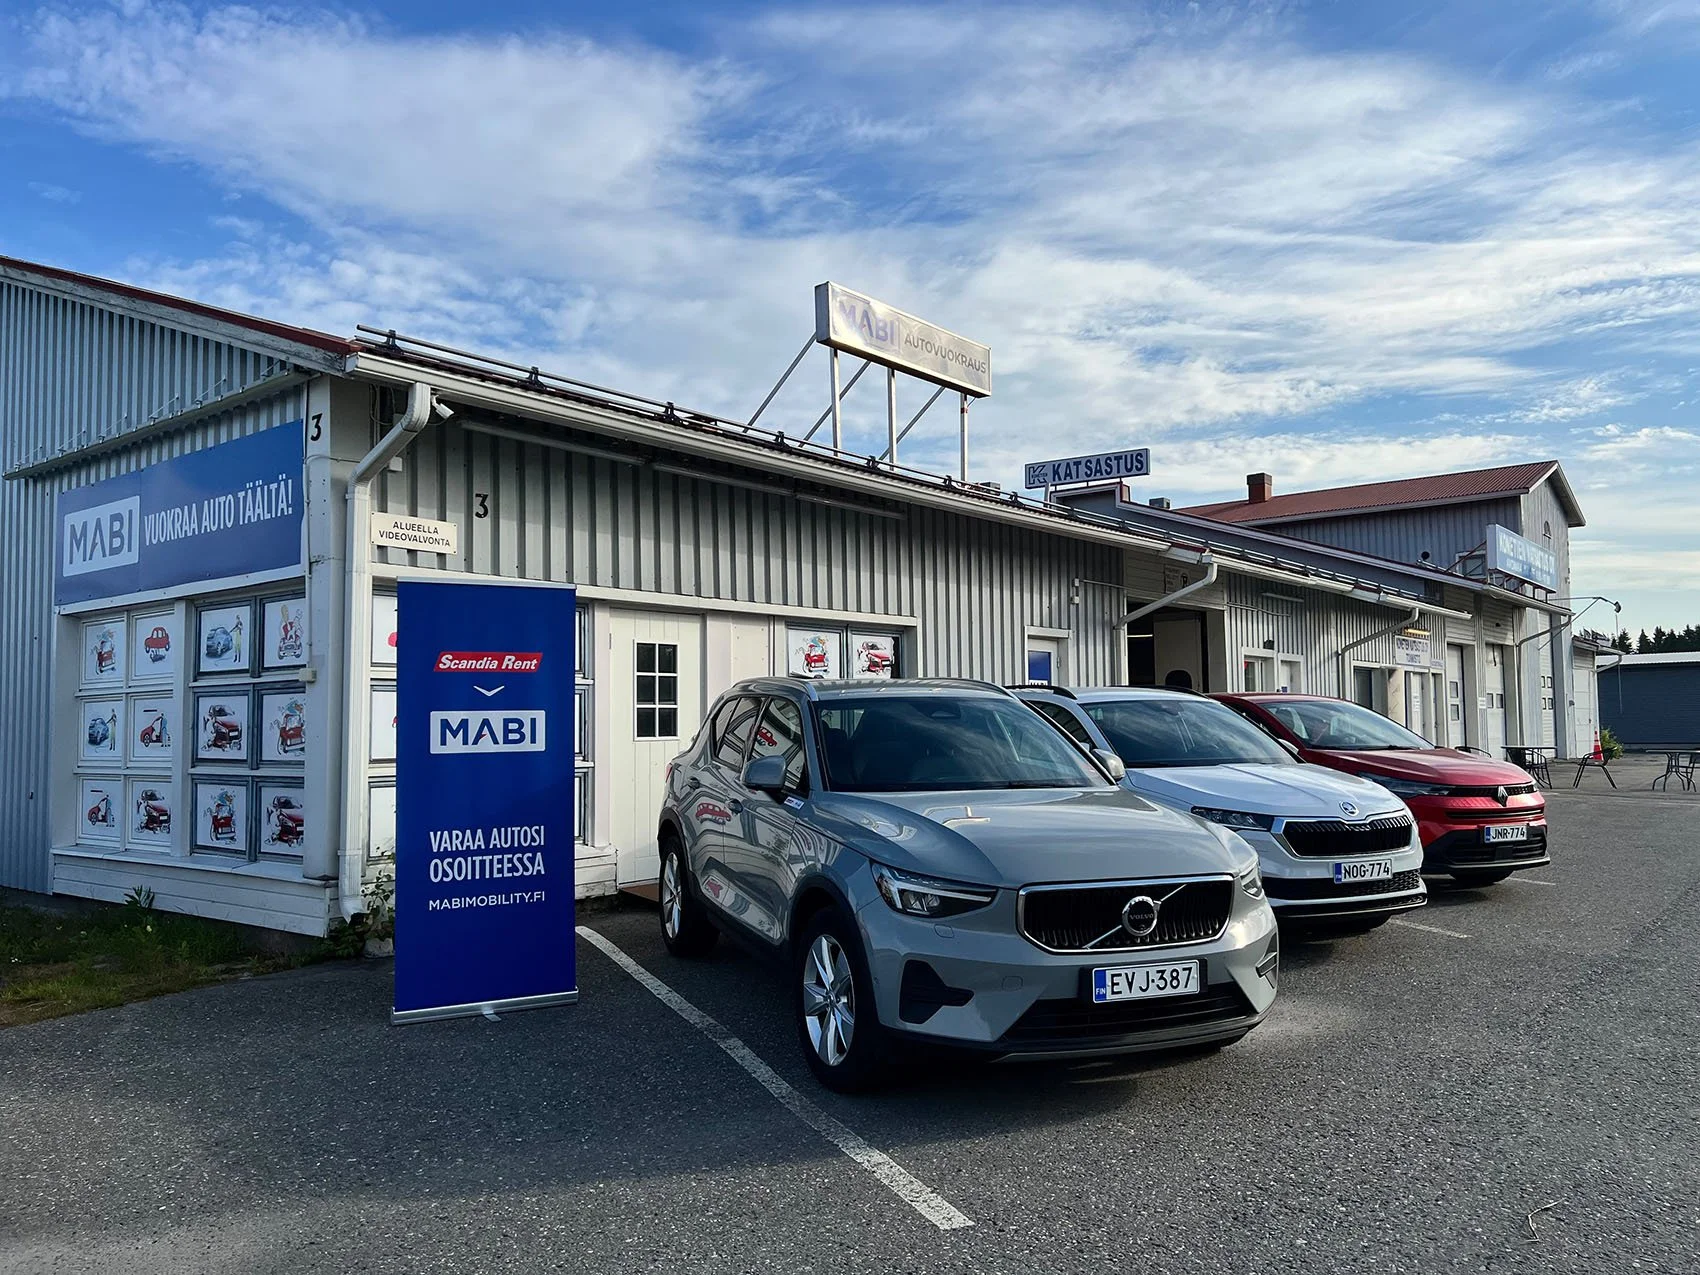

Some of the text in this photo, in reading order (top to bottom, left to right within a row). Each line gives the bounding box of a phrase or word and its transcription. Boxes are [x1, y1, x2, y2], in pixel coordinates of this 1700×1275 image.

[904, 333, 986, 374] AUTOVUOKRAUS
[310, 413, 322, 441] 3
[1052, 452, 1144, 482] KATSASTUS
[144, 474, 293, 546] VUOKRAA AUTO TÄÄLTÄ!
[475, 493, 489, 519] 3
[69, 509, 133, 565] MABI
[378, 530, 450, 547] VIDEOVALVONTA
[392, 521, 439, 535] ALUEELLA
[439, 654, 538, 670] Scandia Rent
[439, 717, 537, 747] MABI
[429, 825, 545, 852] VARAA AUTOSI
[429, 852, 545, 883] OSOITTEESSA
[1343, 862, 1389, 879] NOG-774
[429, 891, 545, 911] MABIMOBILITY.FI
[1110, 967, 1193, 995] EVJ-387
